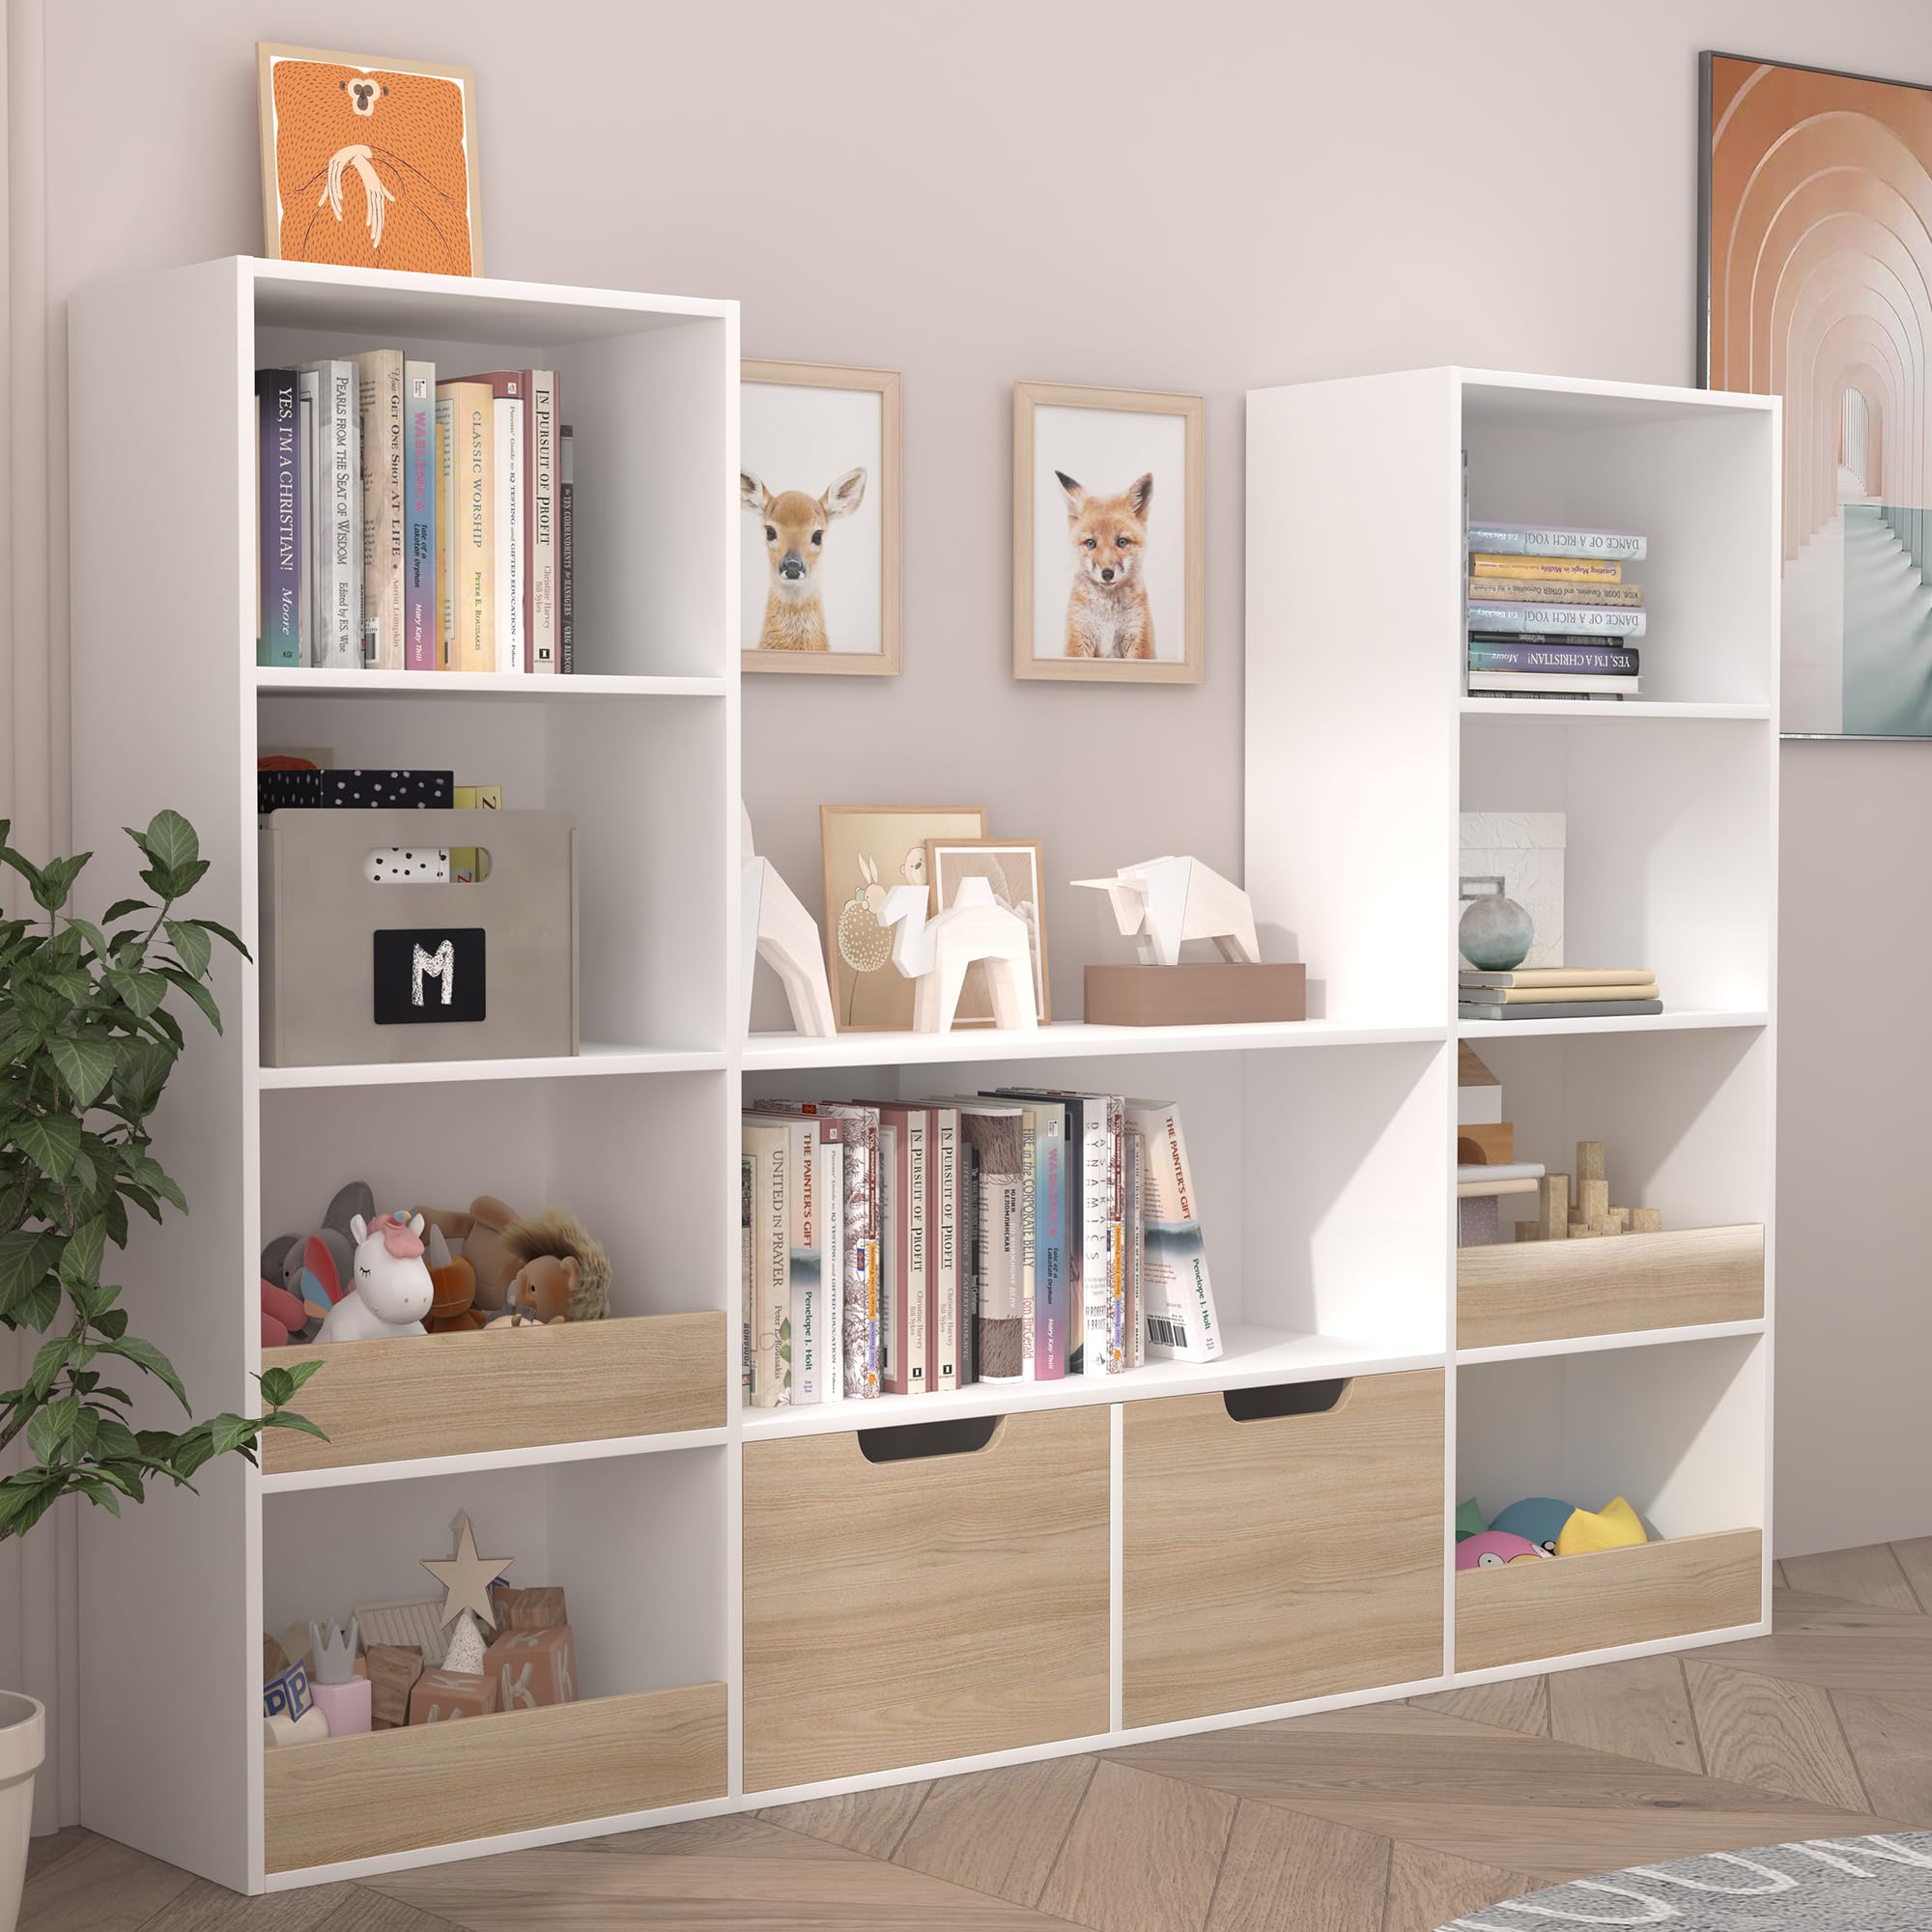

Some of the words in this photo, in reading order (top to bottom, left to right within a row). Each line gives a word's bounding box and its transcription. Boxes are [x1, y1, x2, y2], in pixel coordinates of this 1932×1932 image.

[387, 368, 400, 393] You
[276, 387, 293, 422] YES,
[536, 390, 550, 405] IN
[278, 427, 293, 453] I'M
[473, 412, 482, 473] CLASSIC
[536, 411, 550, 469] PURSUIT
[278, 456, 293, 468] A
[510, 472, 516, 483] IQ
[540, 473, 550, 491] OF
[391, 491, 401, 512] AT
[278, 471, 293, 571] CHRISTIAN!
[473, 480, 482, 549] WORSHIP
[536, 497, 550, 546] PROFIT
[392, 520, 402, 556] LIFE
[1524, 532, 1549, 545] YOGI
[1552, 534, 1577, 546] RICH
[1579, 536, 1587, 547] A
[1589, 536, 1604, 548] OF
[1606, 537, 1639, 551] DANCE
[421, 543, 428, 552] of
[1571, 565, 1589, 575] Magic
[1591, 566, 1617, 577] Creating
[392, 578, 401, 604] Aaron
[535, 582, 544, 594] Bill
[543, 566, 552, 599] Christine
[1544, 586, 1563, 595] OTHER
[339, 582, 349, 605] Edited
[282, 587, 293, 636] Moore
[475, 599, 482, 608] E.
[534, 595, 544, 613] Sykes
[337, 609, 349, 617] by
[542, 602, 552, 629] Harvey
[1524, 611, 1549, 623] YOGI
[1552, 612, 1576, 624] RICH
[1578, 613, 1586, 623] A
[1589, 613, 1603, 625] OF
[1605, 614, 1638, 626] DANCE
[392, 608, 401, 648] Lumpkin
[339, 635, 349, 653] Wise
[1491, 653, 1520, 663] Moore
[1527, 653, 1584, 666] CHRISTIAN!
[1585, 655, 1593, 667] A
[1610, 654, 1631, 668] YES,
[412, 939, 455, 1007] M
[911, 1128, 922, 1143] IN
[942, 1127, 952, 1141] IN
[1166, 1115, 1176, 1139] THE
[1023, 1128, 1035, 1147] FIRE
[1023, 1150, 1035, 1159] in
[911, 1148, 922, 1203] PURSUIT
[942, 1147, 952, 1201] PURSUIT
[1023, 1161, 1035, 1177] the
[1170, 1140, 1186, 1194] PAINTER'S
[773, 1151, 783, 1211] UNITED
[831, 1211, 837, 1222] IQ
[914, 1206, 922, 1222] OF
[945, 1204, 952, 1220] OF
[1023, 1179, 1035, 1236] CORPORATE
[1179, 1195, 1191, 1221] GIFT
[773, 1214, 782, 1228] IN
[911, 1227, 922, 1273] PROFIT
[942, 1225, 952, 1270] PROFIT
[1023, 1239, 1035, 1268] BELLY
[773, 1232, 783, 1287] PRAYER
[1192, 1258, 1208, 1299] Penelope
[803, 1292, 812, 1335] Penelope
[1023, 1295, 1035, 1316] Tom
[1200, 1300, 1208, 1309] J.
[1201, 1311, 1211, 1330] Holt
[805, 1350, 813, 1371] Holt
[288, 1672, 308, 1714] P
[501, 1662, 539, 1711] K
